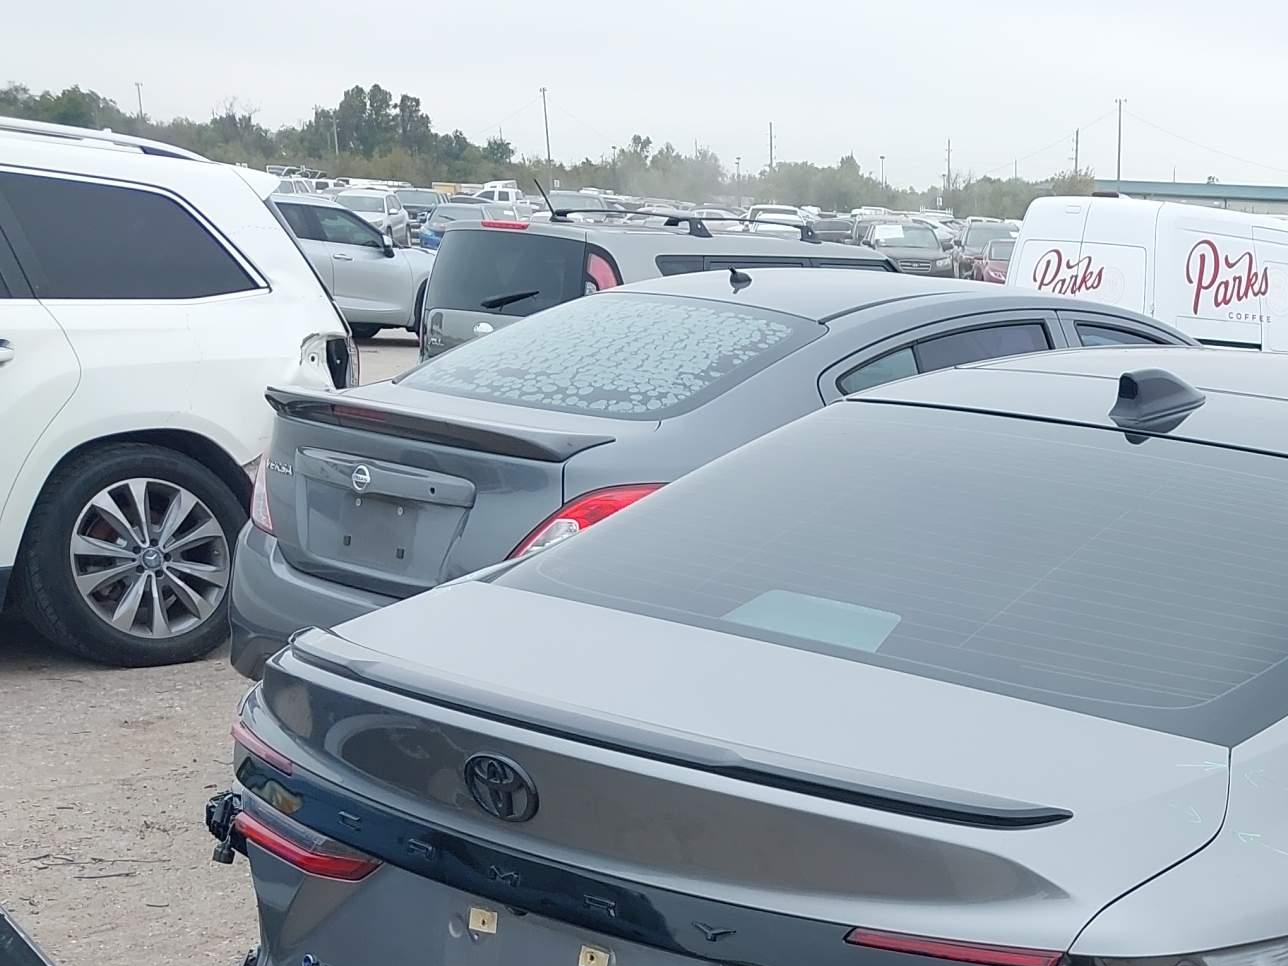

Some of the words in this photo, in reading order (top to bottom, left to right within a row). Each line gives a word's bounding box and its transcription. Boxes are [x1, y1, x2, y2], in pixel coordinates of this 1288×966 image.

[1033, 249, 1104, 295] Parks
[1186, 240, 1268, 315] Parks
[1228, 312, 1272, 323] COFFEE
